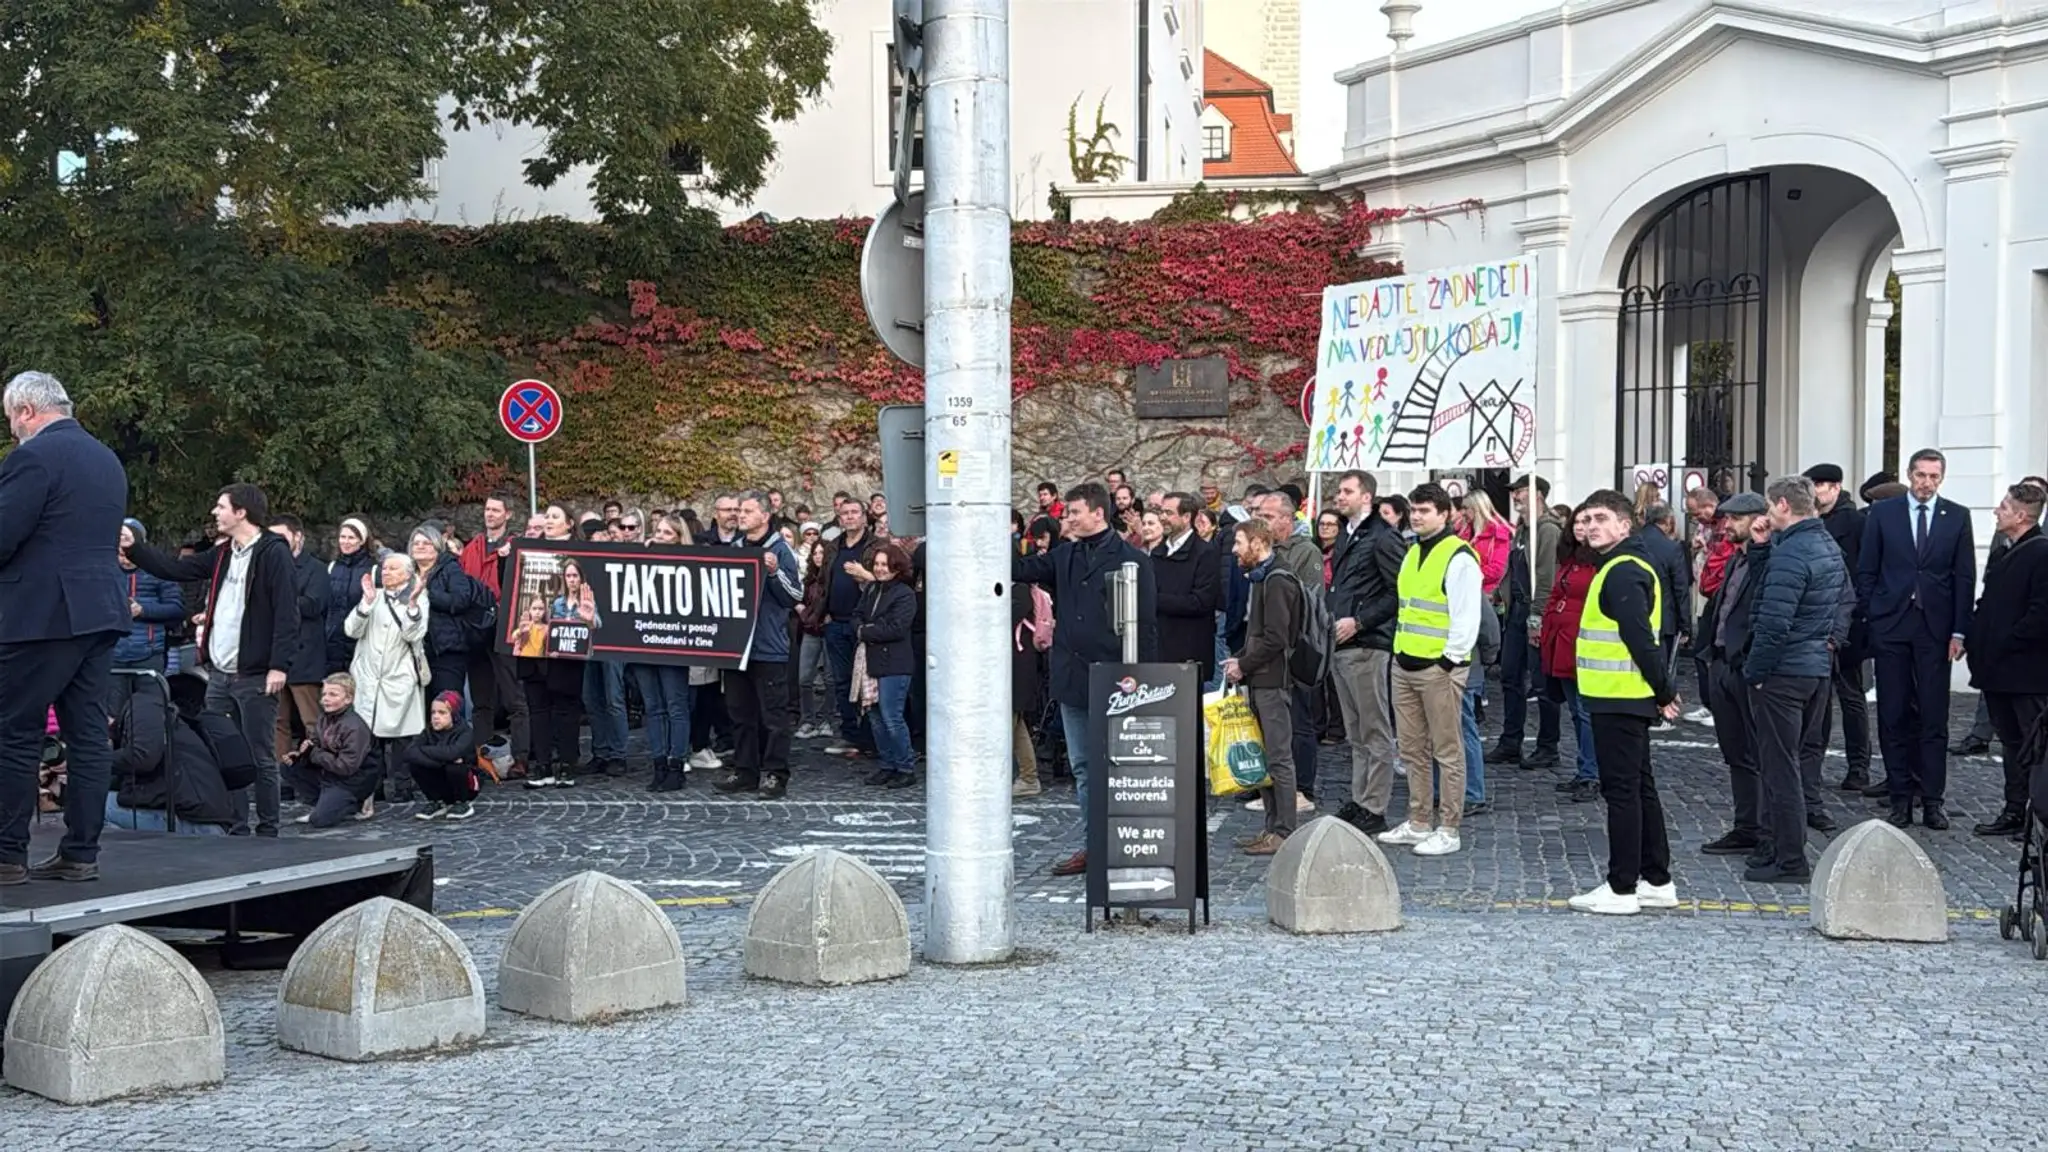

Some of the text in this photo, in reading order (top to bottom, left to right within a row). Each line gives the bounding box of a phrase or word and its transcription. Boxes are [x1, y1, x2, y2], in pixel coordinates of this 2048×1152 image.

[1332, 282, 1418, 335] NEDAJTE
[1327, 337, 1357, 368] NA
[948, 397, 973, 408] 1359
[953, 416, 967, 426] 65
[605, 563, 747, 619] TAKTO NIE
[551, 626, 589, 639] #TAKTO
[634, 619, 680, 632] Zjednotení
[688, 623, 718, 636] postoji
[558, 638, 577, 653] NIE
[642, 634, 687, 646] Odhodlaní
[1119, 733, 1166, 741] Restaurant
[1108, 776, 1175, 789] Reštaurácia
[1114, 789, 1168, 802] otvorená
[1117, 826, 1165, 840] We are
[1123, 843, 1159, 858] open
